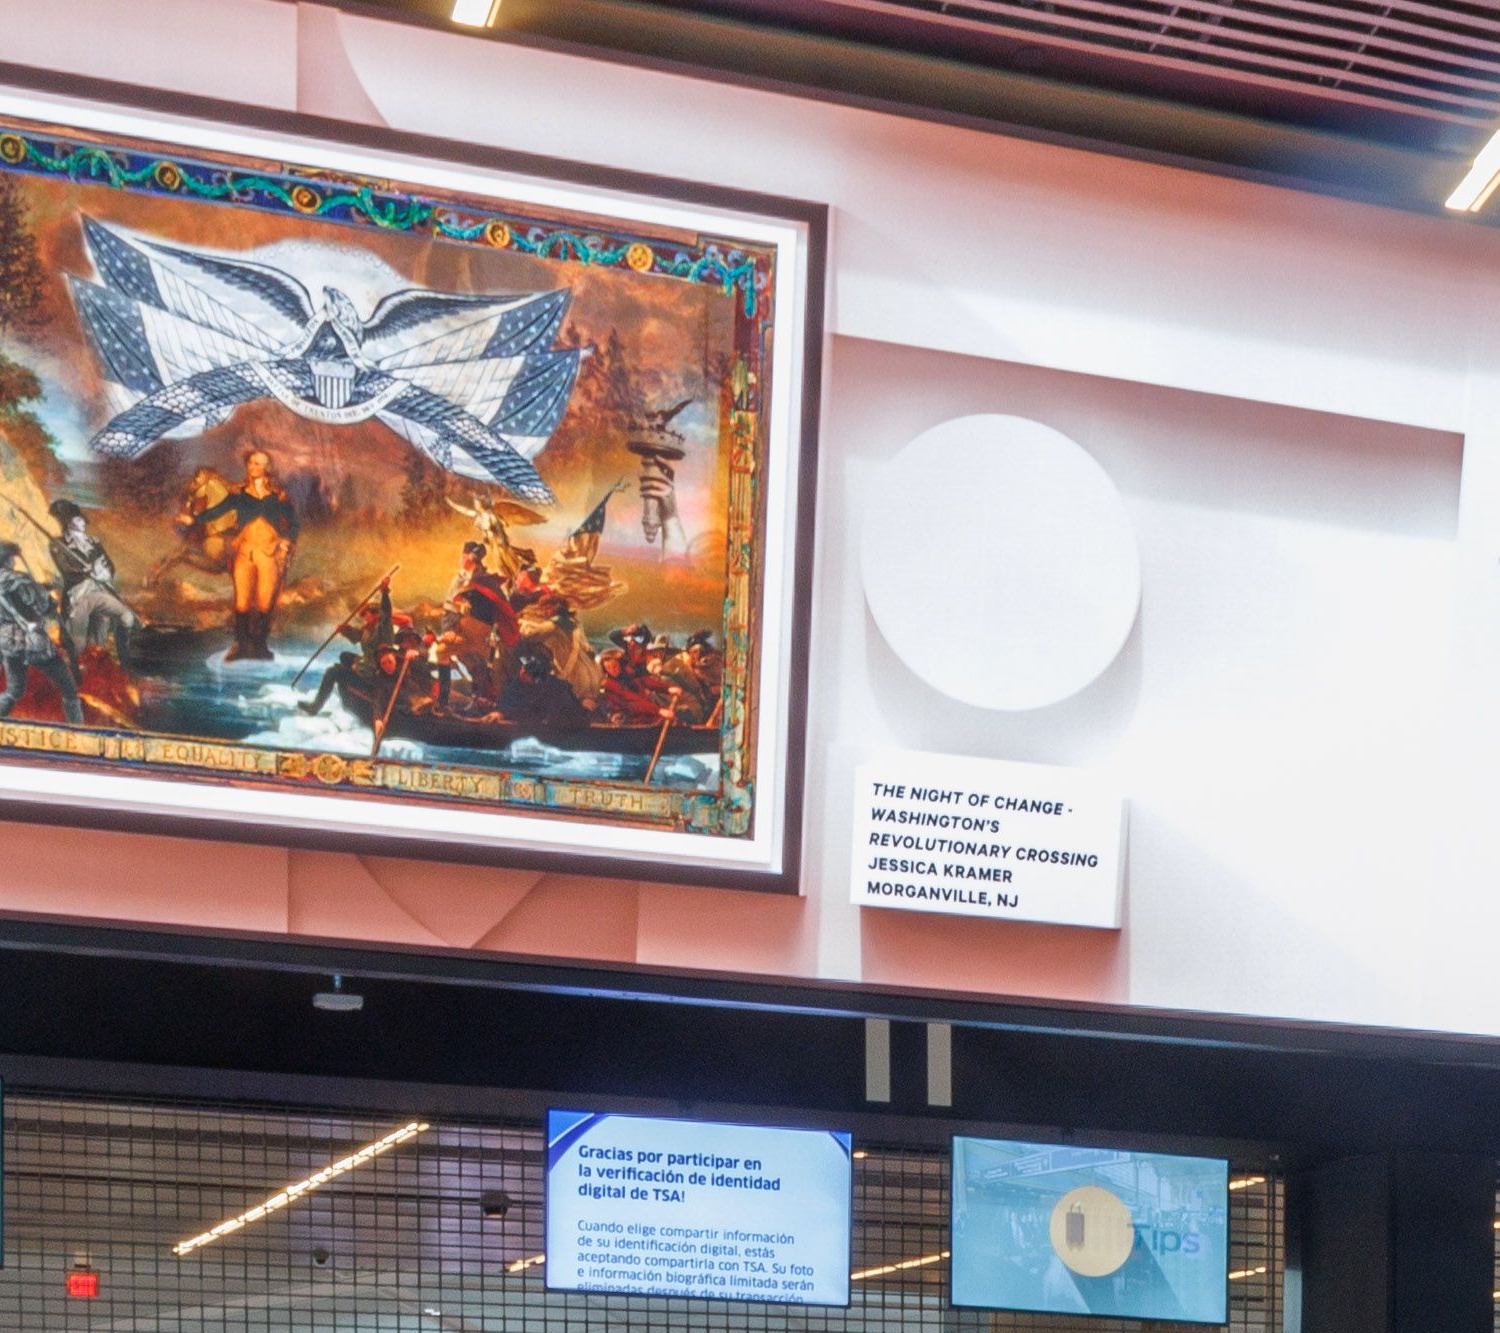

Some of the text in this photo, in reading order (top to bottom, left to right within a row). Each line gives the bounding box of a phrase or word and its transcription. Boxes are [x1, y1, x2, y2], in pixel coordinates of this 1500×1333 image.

[162, 743, 263, 771] EQUALITY
[398, 762, 484, 793] LIBERTY
[568, 786, 647, 808] TRUTH
[873, 783, 906, 799] THE
[910, 787, 963, 804] NIGHT
[968, 793, 990, 807] OF
[994, 796, 1064, 816] CHANGE
[870, 807, 1001, 833] WASHINGTON'S
[869, 832, 1099, 868] REVOLUTIONARY CROSSING
[868, 857, 1013, 883] JESSICA KRAMER
[867, 881, 1019, 908] MORGANVILLE, NJ
[865, 1018, 952, 1107] 11
[578, 1144, 762, 1171] Gracias por participar en
[578, 1164, 781, 1191] la verificación de identidad
[578, 1183, 685, 1203] digital de TSA!
[577, 1219, 795, 1245] Cuando elige compartir información
[1127, 1222, 1200, 1258] Tips
[577, 1235, 593, 1248] de
[596, 1239, 610, 1249] su
[614, 1237, 697, 1254] identificación
[744, 1246, 776, 1260] estás
[577, 1251, 641, 1267] aceptando
[644, 1254, 715, 1271] compartirla
[718, 1260, 740, 1272] con
[772, 1263, 787, 1276] Su
[790, 1263, 814, 1277] foto
[577, 1266, 814, 1292] e información biográfica limitada serán
